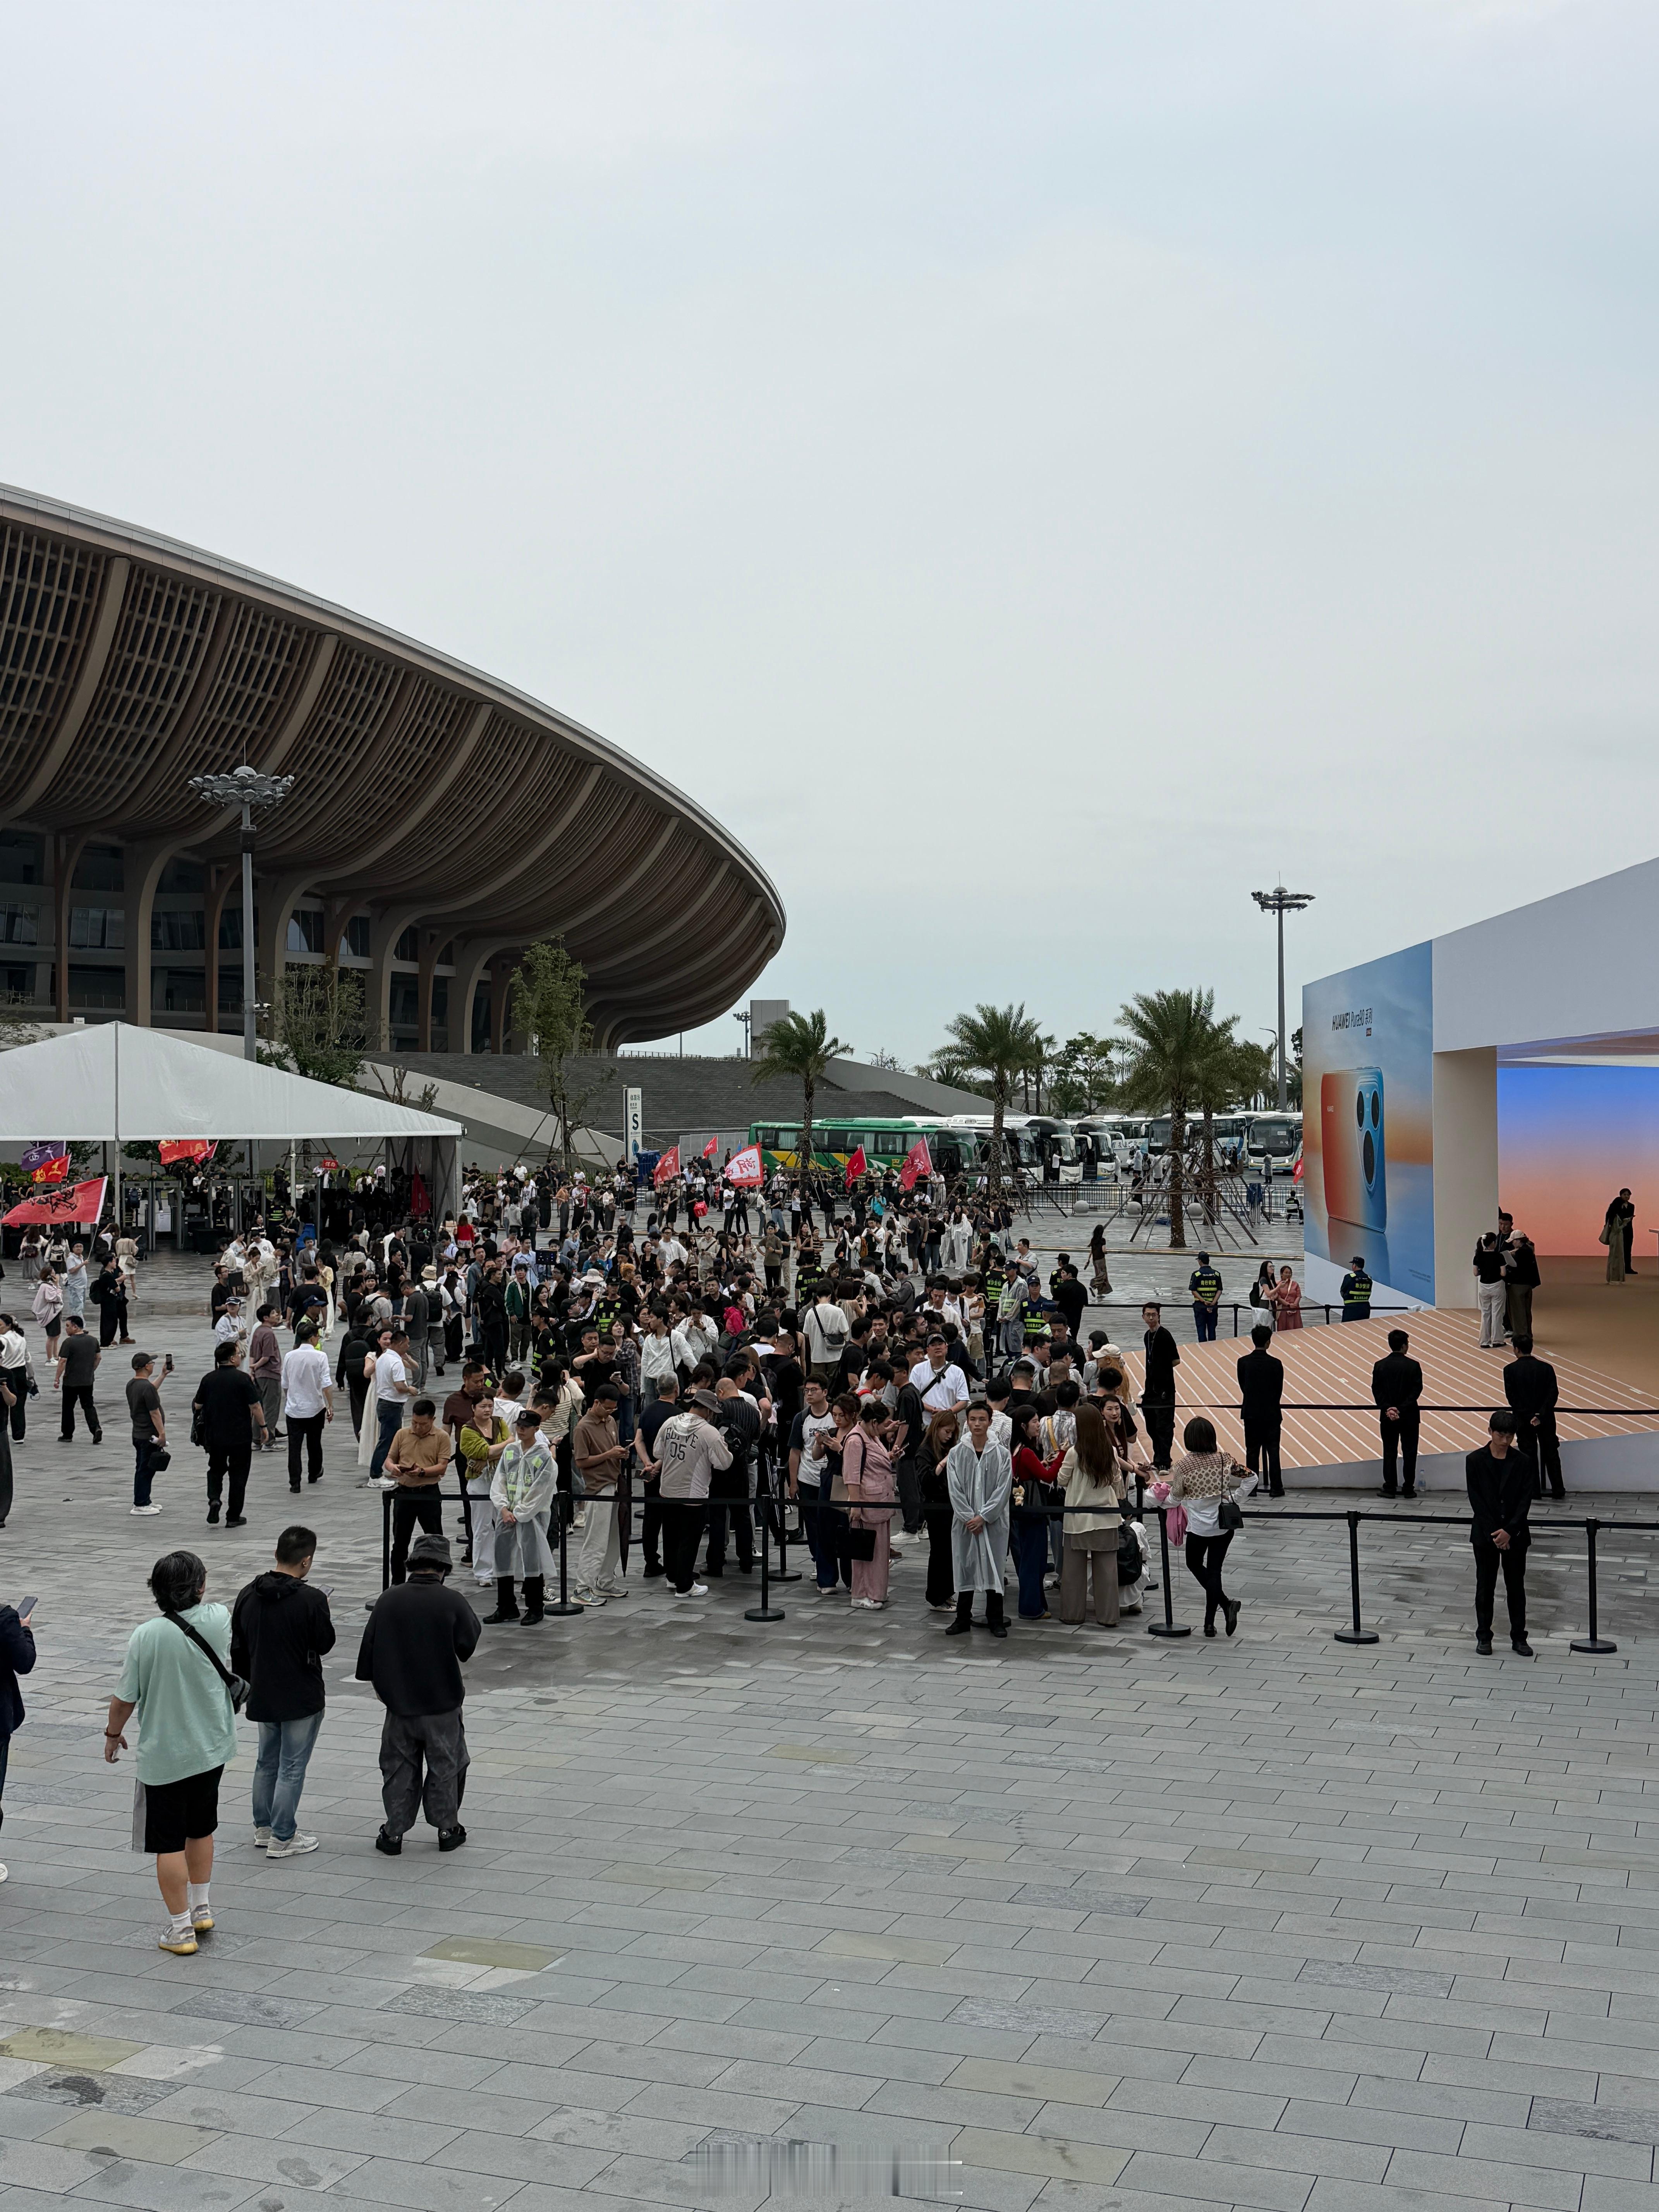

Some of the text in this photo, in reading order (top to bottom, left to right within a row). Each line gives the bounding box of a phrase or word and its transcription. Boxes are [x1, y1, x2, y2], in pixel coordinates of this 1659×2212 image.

[1332, 1012, 1350, 1031] HUAWEI
[632, 1113, 639, 1130] S
[670, 1441, 687, 1461] 05
